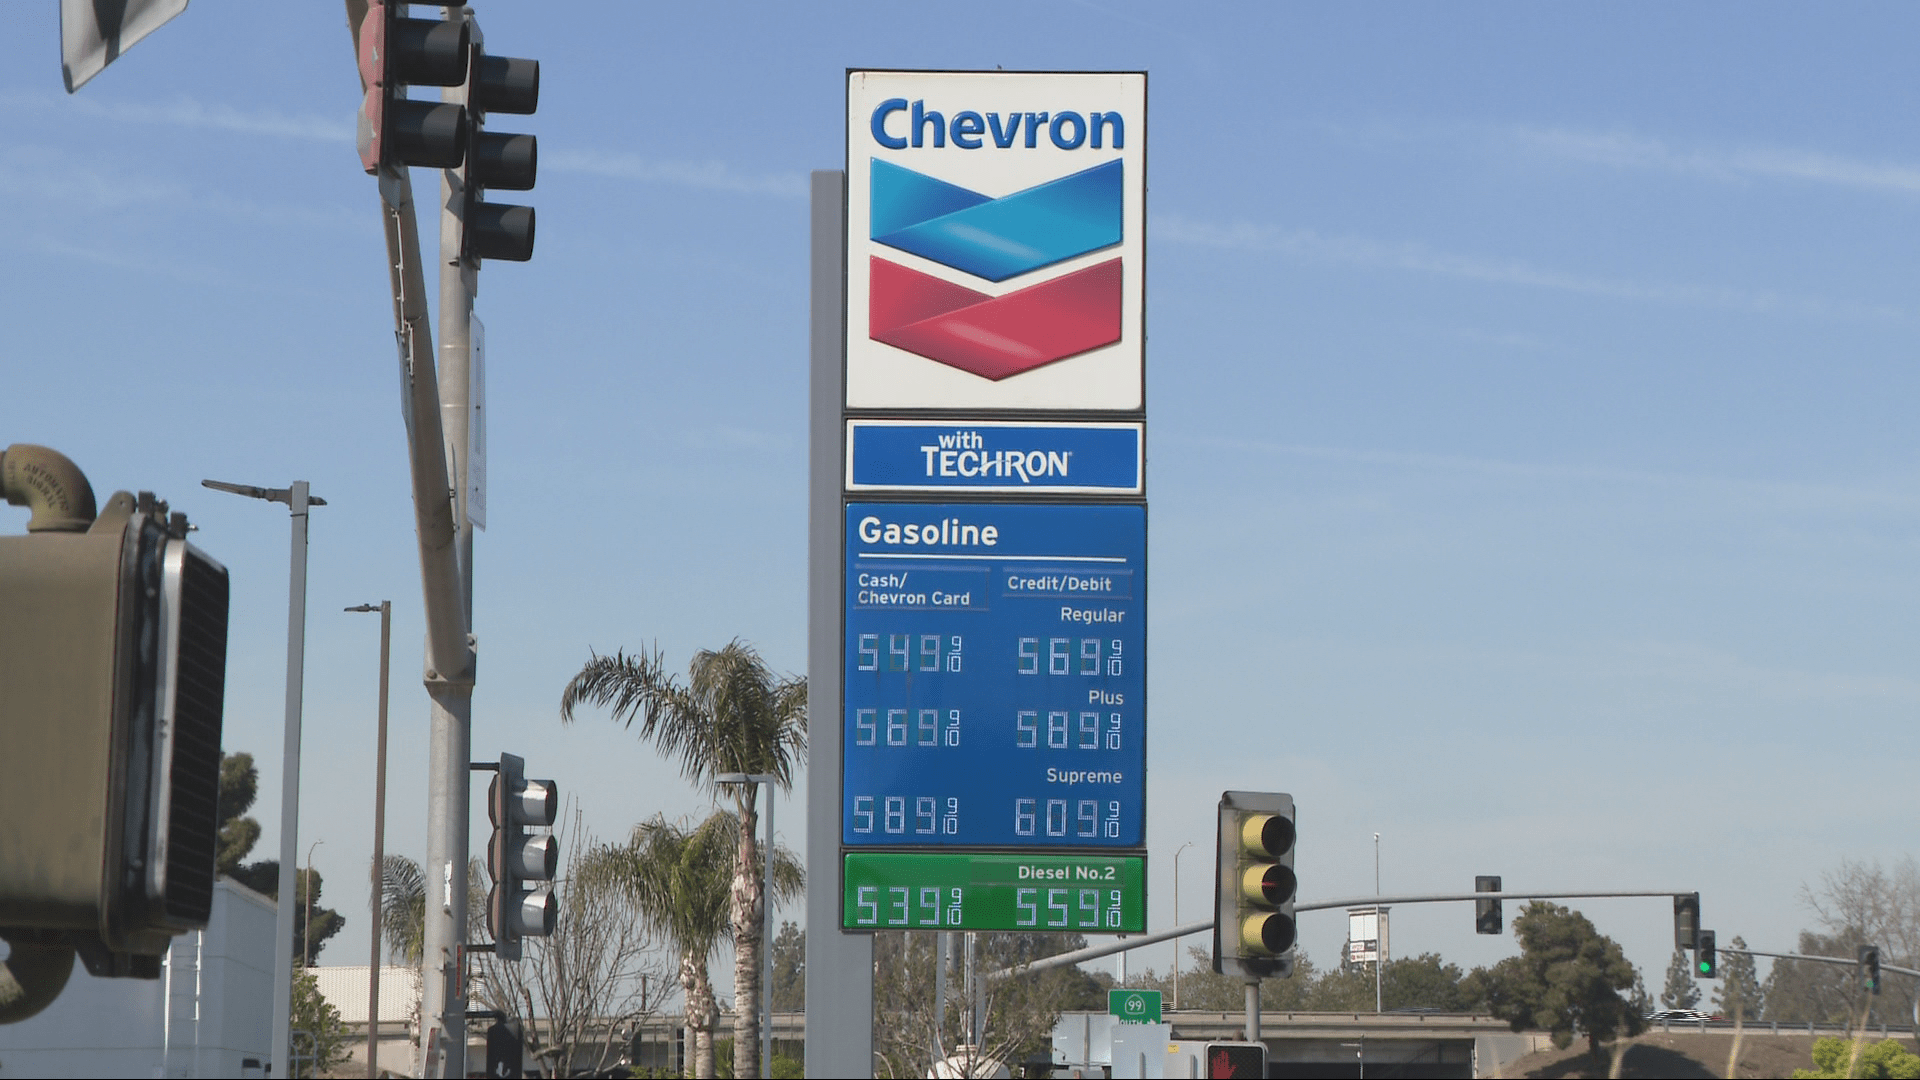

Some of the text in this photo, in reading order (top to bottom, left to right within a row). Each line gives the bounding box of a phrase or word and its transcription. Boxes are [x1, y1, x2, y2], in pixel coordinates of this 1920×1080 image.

[870, 98, 1125, 151] Chevron
[938, 430, 983, 449] with
[858, 516, 999, 546] Gasoline
[858, 572, 908, 589] Cash/
[1007, 575, 1112, 592] Credit/Debit
[858, 590, 970, 606] Chevron Card
[1061, 606, 1125, 625] Regular
[858, 633, 941, 672] 549
[1017, 637, 1101, 676] 569
[1089, 690, 1124, 705] Plus
[856, 708, 938, 746] 569
[1016, 710, 1100, 750] 589
[1047, 767, 1122, 785] Supreme
[853, 795, 936, 835] 589
[1015, 798, 1098, 838] 609
[1018, 865, 1116, 880] Diesel No.2
[857, 886, 941, 925] 539
[1016, 887, 1100, 928] 559
[1128, 1000, 1142, 1011] 99
